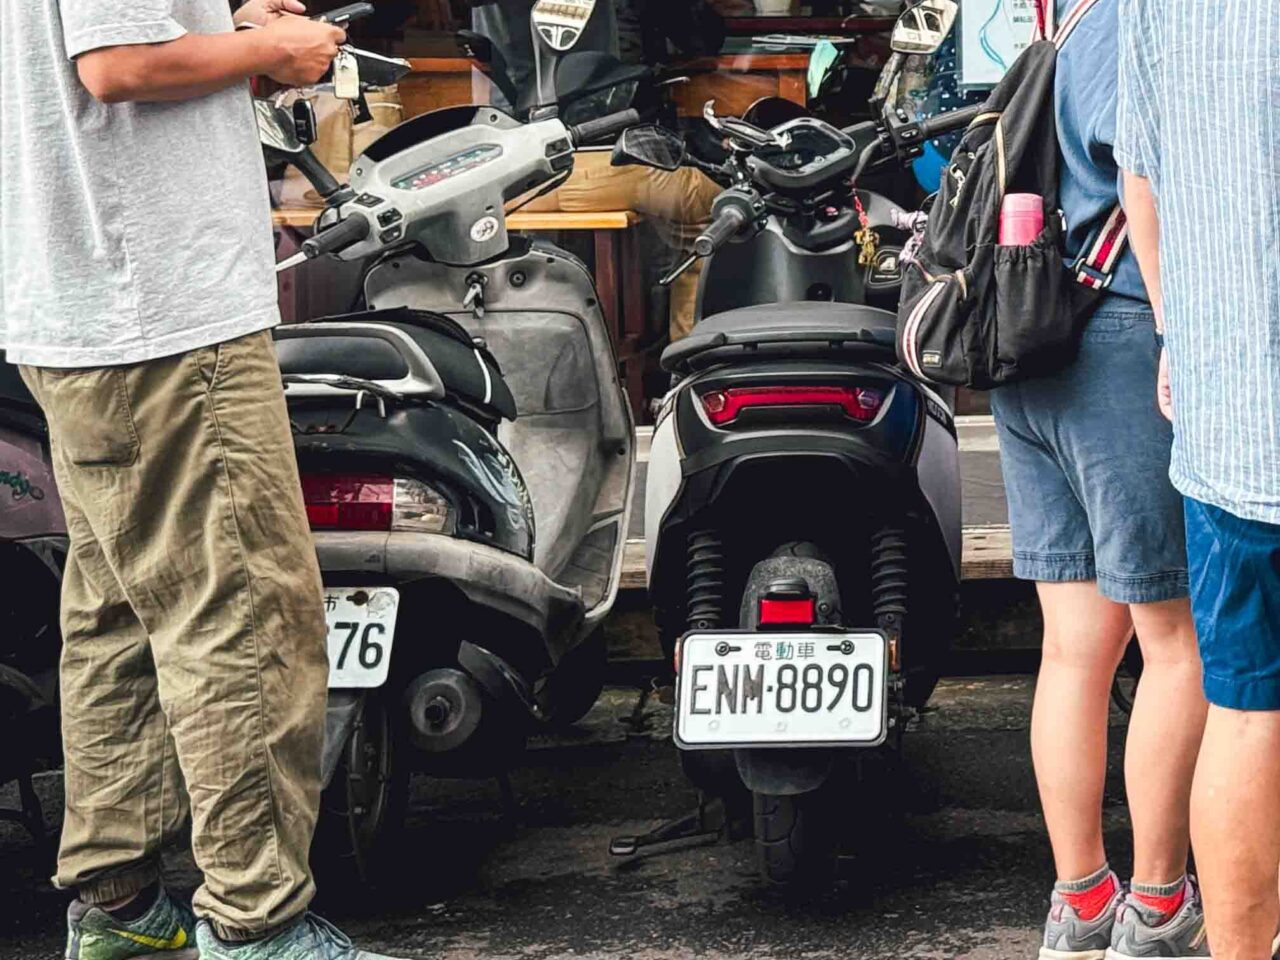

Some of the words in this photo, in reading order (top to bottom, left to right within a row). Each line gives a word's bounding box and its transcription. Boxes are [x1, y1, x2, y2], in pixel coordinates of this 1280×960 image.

[326, 621, 387, 671] 76
[753, 641, 816, 661] 電動車
